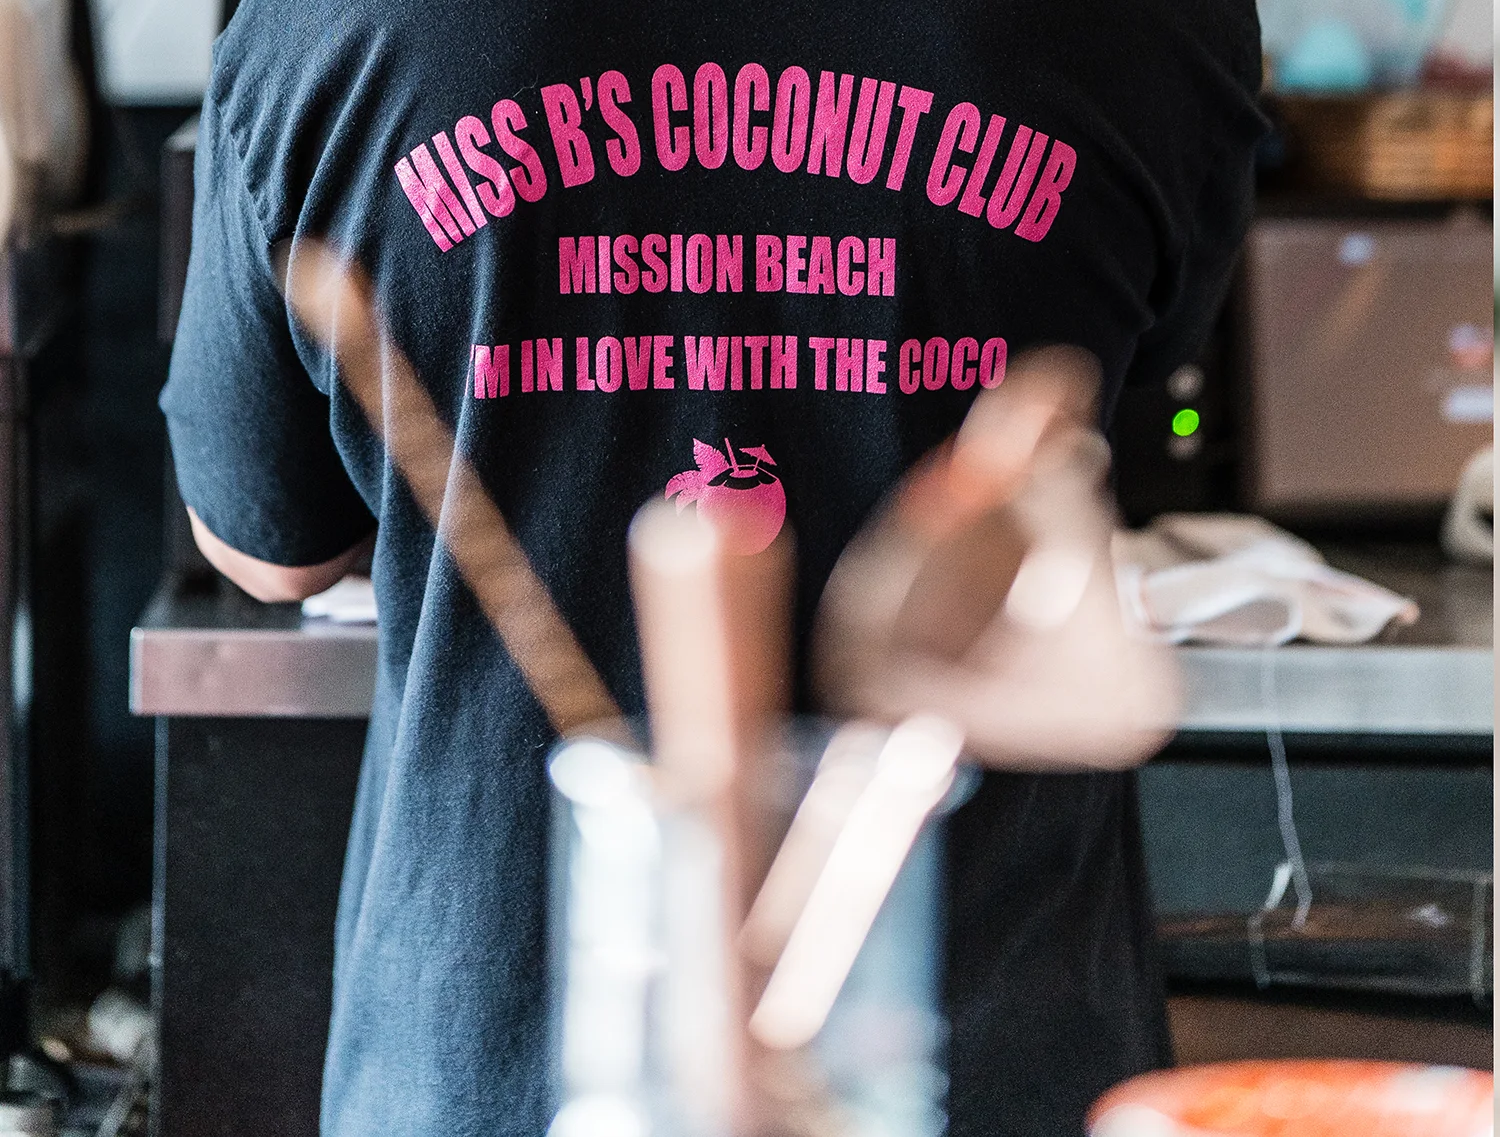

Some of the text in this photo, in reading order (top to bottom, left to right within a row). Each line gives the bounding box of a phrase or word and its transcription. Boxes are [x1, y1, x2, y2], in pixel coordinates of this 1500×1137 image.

[394, 61, 1077, 253] MISS B'S COCONUT CLUB
[558, 233, 896, 297] MISSION BEACH
[521, 337, 564, 393] IN
[575, 335, 675, 394] LOVE
[683, 335, 798, 392] WITH
[808, 336, 887, 395] THE
[899, 336, 1008, 396] COCO
